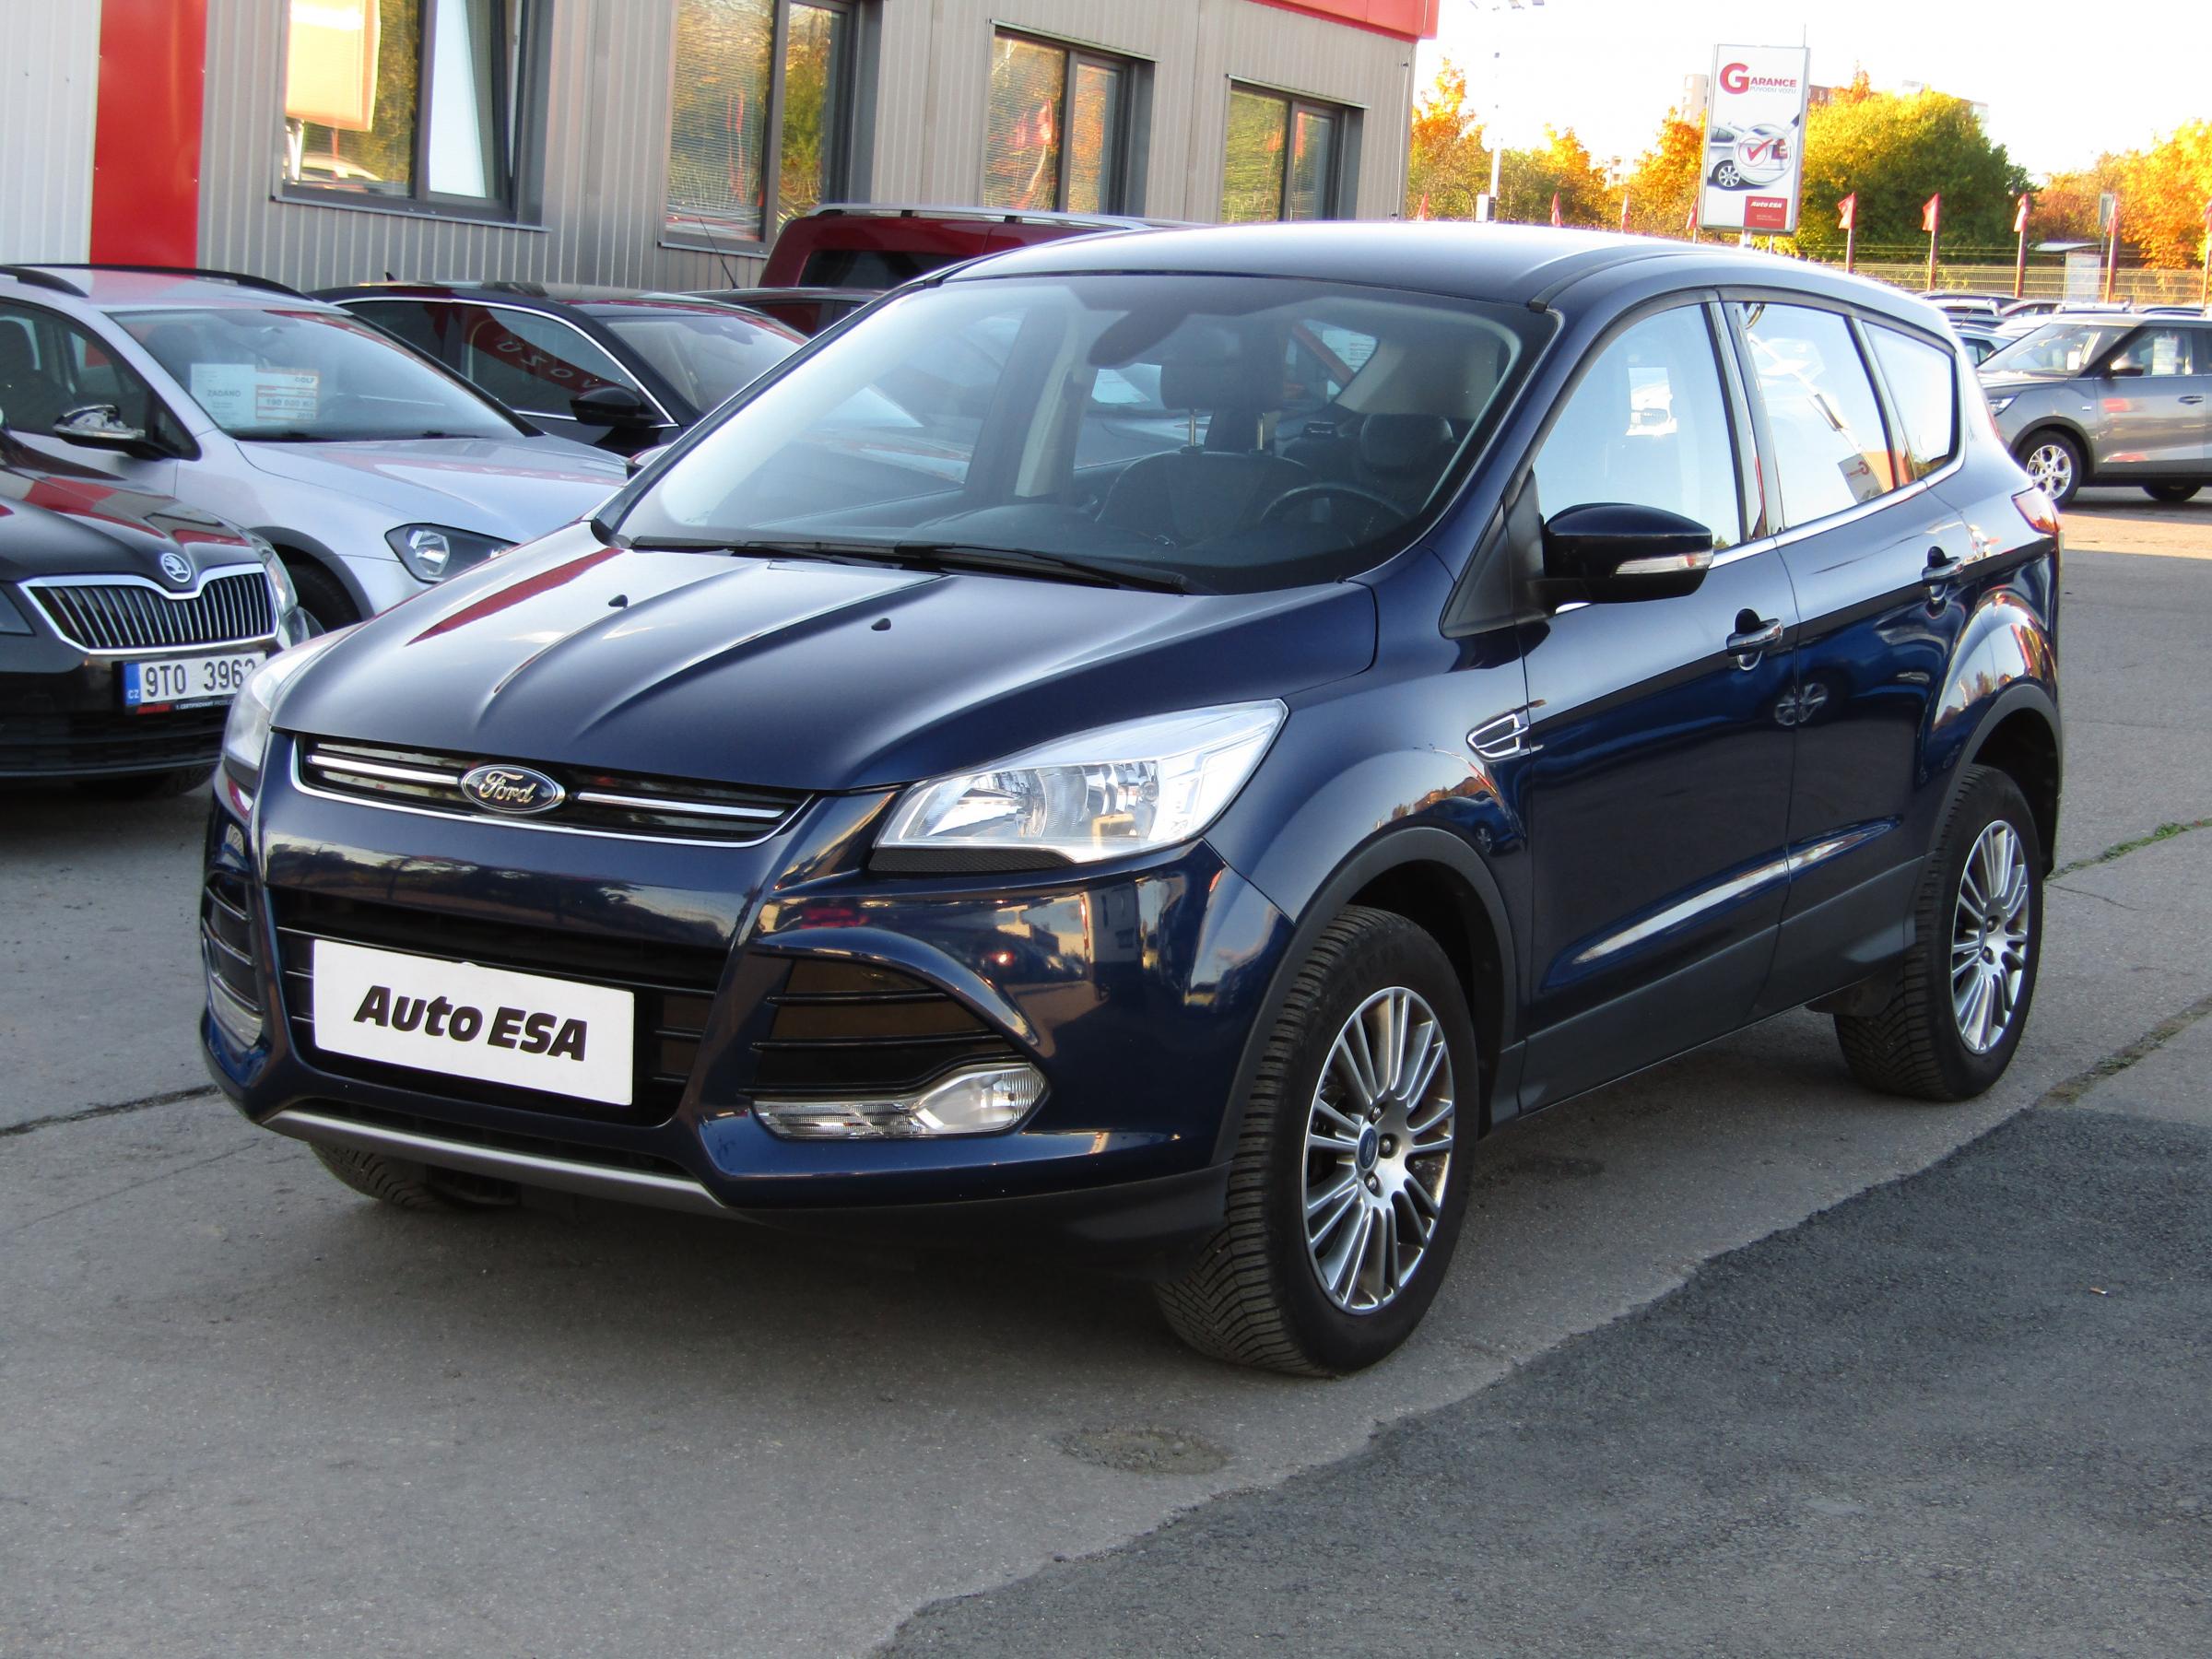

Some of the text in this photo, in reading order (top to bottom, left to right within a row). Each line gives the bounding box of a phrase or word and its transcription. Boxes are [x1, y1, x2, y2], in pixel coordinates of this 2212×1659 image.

[1719, 62, 1797, 95] GARANCE
[127, 689, 139, 700] CZ
[478, 771, 537, 804] Ford
[353, 984, 588, 1063] Auto ESA
